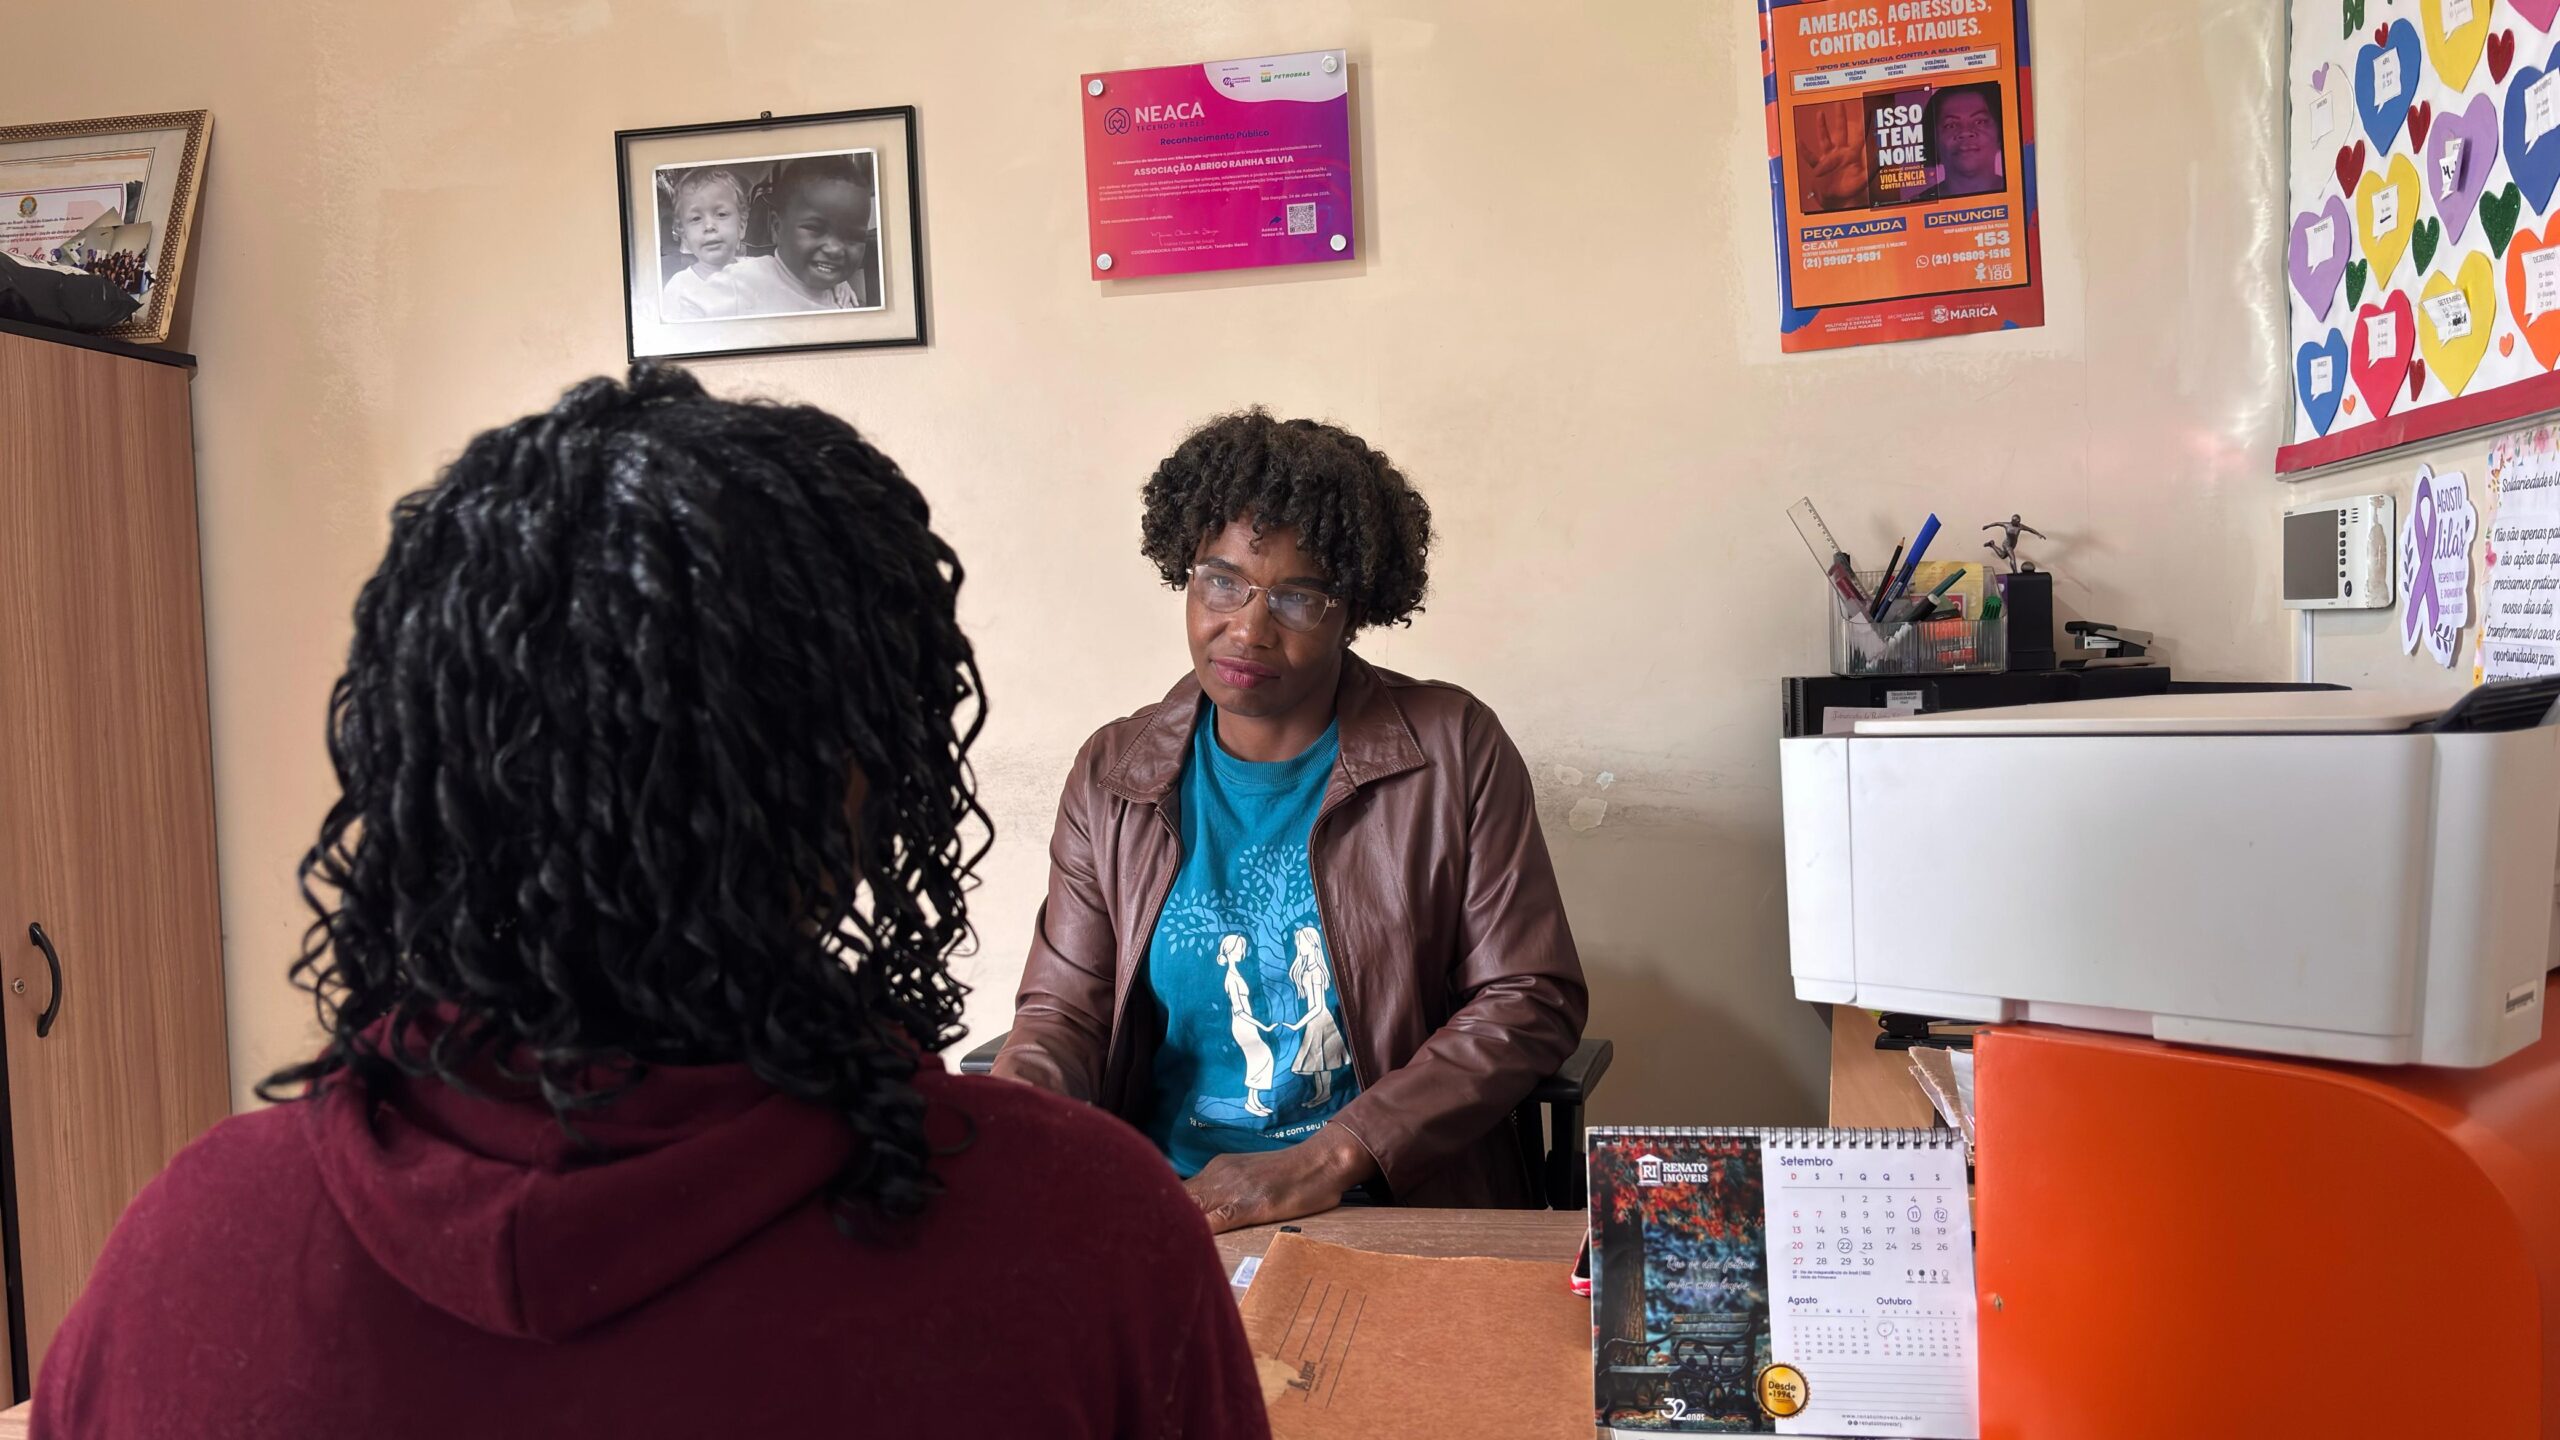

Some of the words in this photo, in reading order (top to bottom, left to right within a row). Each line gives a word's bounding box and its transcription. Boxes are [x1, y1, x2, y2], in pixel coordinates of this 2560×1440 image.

[1799, 8, 1883, 35] AMEAÇAS,
[1809, 28, 1902, 57] CONTROLE,
[1906, 18, 1982, 44] ATAQUES.
[1815, 63, 1839, 71] TIPOS
[1852, 56, 1894, 66] VIOLÊNCIA
[1895, 51, 1929, 60] CONTRA
[1938, 46, 1971, 54] MULHER
[1274, 71, 1310, 80] PETROBRAS
[1135, 102, 1205, 123] NEACA
[1876, 104, 1923, 128] ISSO
[1137, 123, 1176, 132] TECENDO
[1236, 129, 1270, 139] Público
[1877, 124, 1924, 148] TEM
[1134, 162, 1193, 176] ASSOCIAÇÃO
[1194, 160, 1228, 171] ABRIGO
[1229, 157, 1264, 168] RAINHA
[1265, 154, 1295, 165] SILVIA
[1880, 170, 1926, 184] VIOLÊNCIA
[1928, 208, 2006, 225] DENUNCIE
[1803, 227, 1844, 240] PEÇA
[1848, 220, 1903, 235] AJUDA
[1975, 230, 2010, 247] 153
[1802, 241, 1838, 251] CEAM
[1803, 257, 1822, 270] (21)
[1932, 252, 1951, 266] (21)
[1989, 269, 2013, 281] 180
[1950, 305, 1998, 320] MARICÁ
[2502, 472, 2548, 493] Solidariedade
[2548, 475, 2553, 487] e
[2437, 486, 2462, 514] AGOSTO
[2435, 517, 2466, 560] lilás
[2494, 527, 2507, 542] Não
[2507, 526, 2520, 542] são
[2520, 527, 2547, 546] apenas
[2500, 550, 2513, 567] são
[2513, 550, 2535, 570] ações
[2535, 548, 2550, 565] das
[2492, 575, 2531, 596] precisamos
[2529, 575, 2559, 596] praticar
[2501, 602, 2523, 615] nosso
[2523, 598, 2535, 615] dia
[2541, 598, 2553, 618] dia,
[2486, 622, 2532, 641] transformando
[2537, 629, 2555, 641] caos
[2493, 647, 2538, 667] oportunidades
[2537, 653, 2555, 671] para
[1286, 1125, 1305, 1136] com
[1306, 1122, 1321, 1132] seu
[1642, 1164, 1657, 1178] RI
[1662, 1162, 1708, 1173] RENATO
[1780, 1156, 1833, 1167] Setembro
[1663, 1172, 1709, 1183] IMÓVEIS
[1859, 1173, 1867, 1181] Q
[1883, 1173, 1890, 1181] Q
[1792, 1242, 1803, 1250] 20
[1817, 1242, 1825, 1250] 21
[1840, 1242, 1850, 1250] 22
[1862, 1242, 1873, 1250] 23
[1886, 1242, 1897, 1250] 24
[1911, 1242, 1922, 1250] 25
[1937, 1242, 1948, 1250] 26
[1788, 1296, 1818, 1305] Agosto
[1876, 1296, 1912, 1305] Outubro
[1768, 1380, 1797, 1392] Desde
[1772, 1389, 1792, 1398] 1994
[1661, 1397, 1687, 1421] 32
[1686, 1413, 1705, 1421] anos
